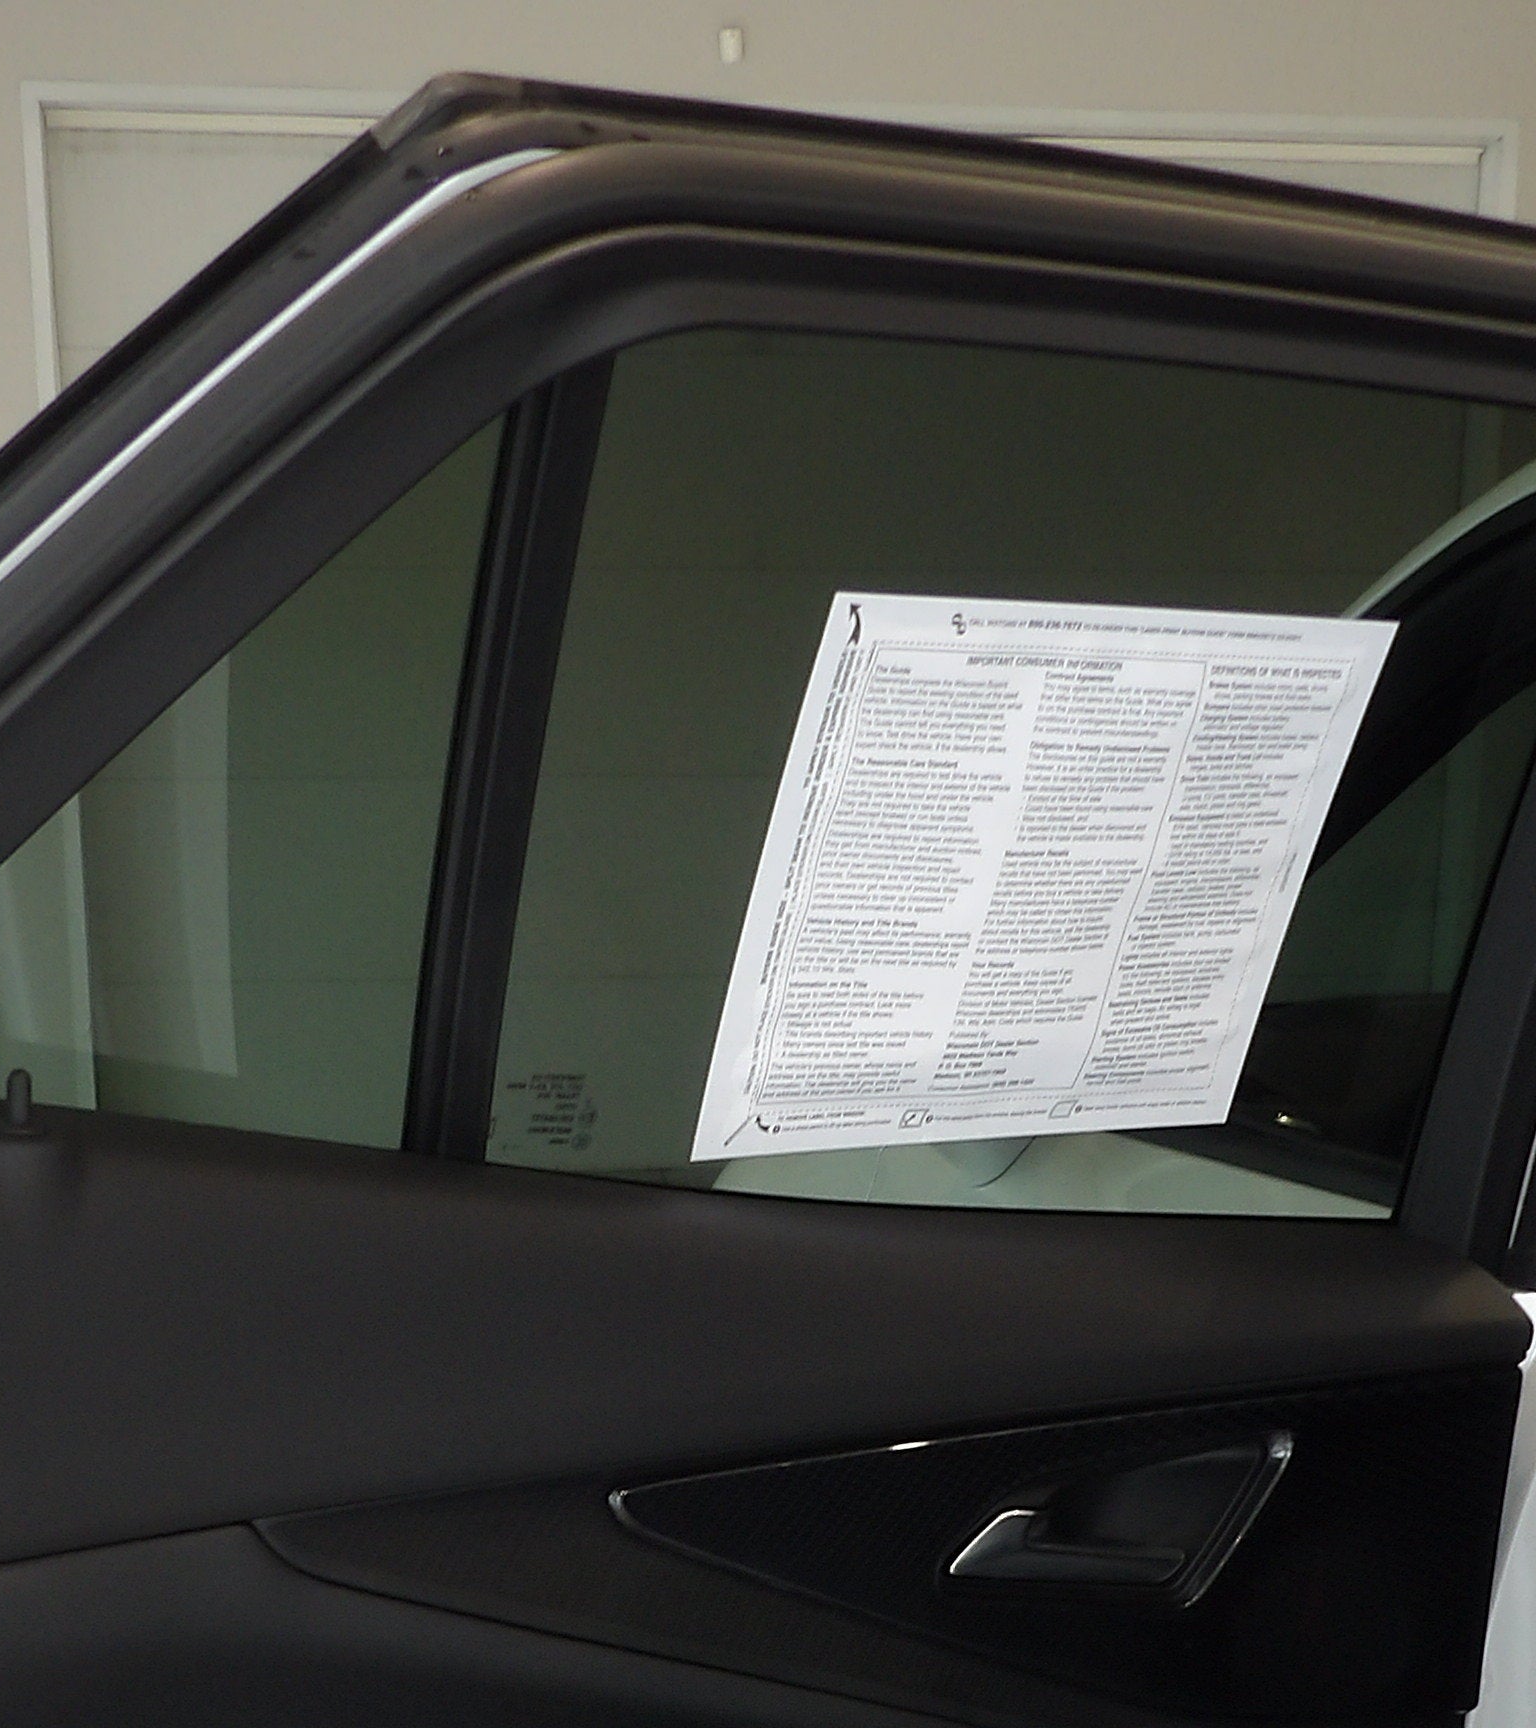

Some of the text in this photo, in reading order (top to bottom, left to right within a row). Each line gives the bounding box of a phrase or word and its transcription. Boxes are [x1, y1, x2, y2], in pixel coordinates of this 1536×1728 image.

[967, 656, 1123, 670] IMPORTANT CONSUMER INFORMATION
